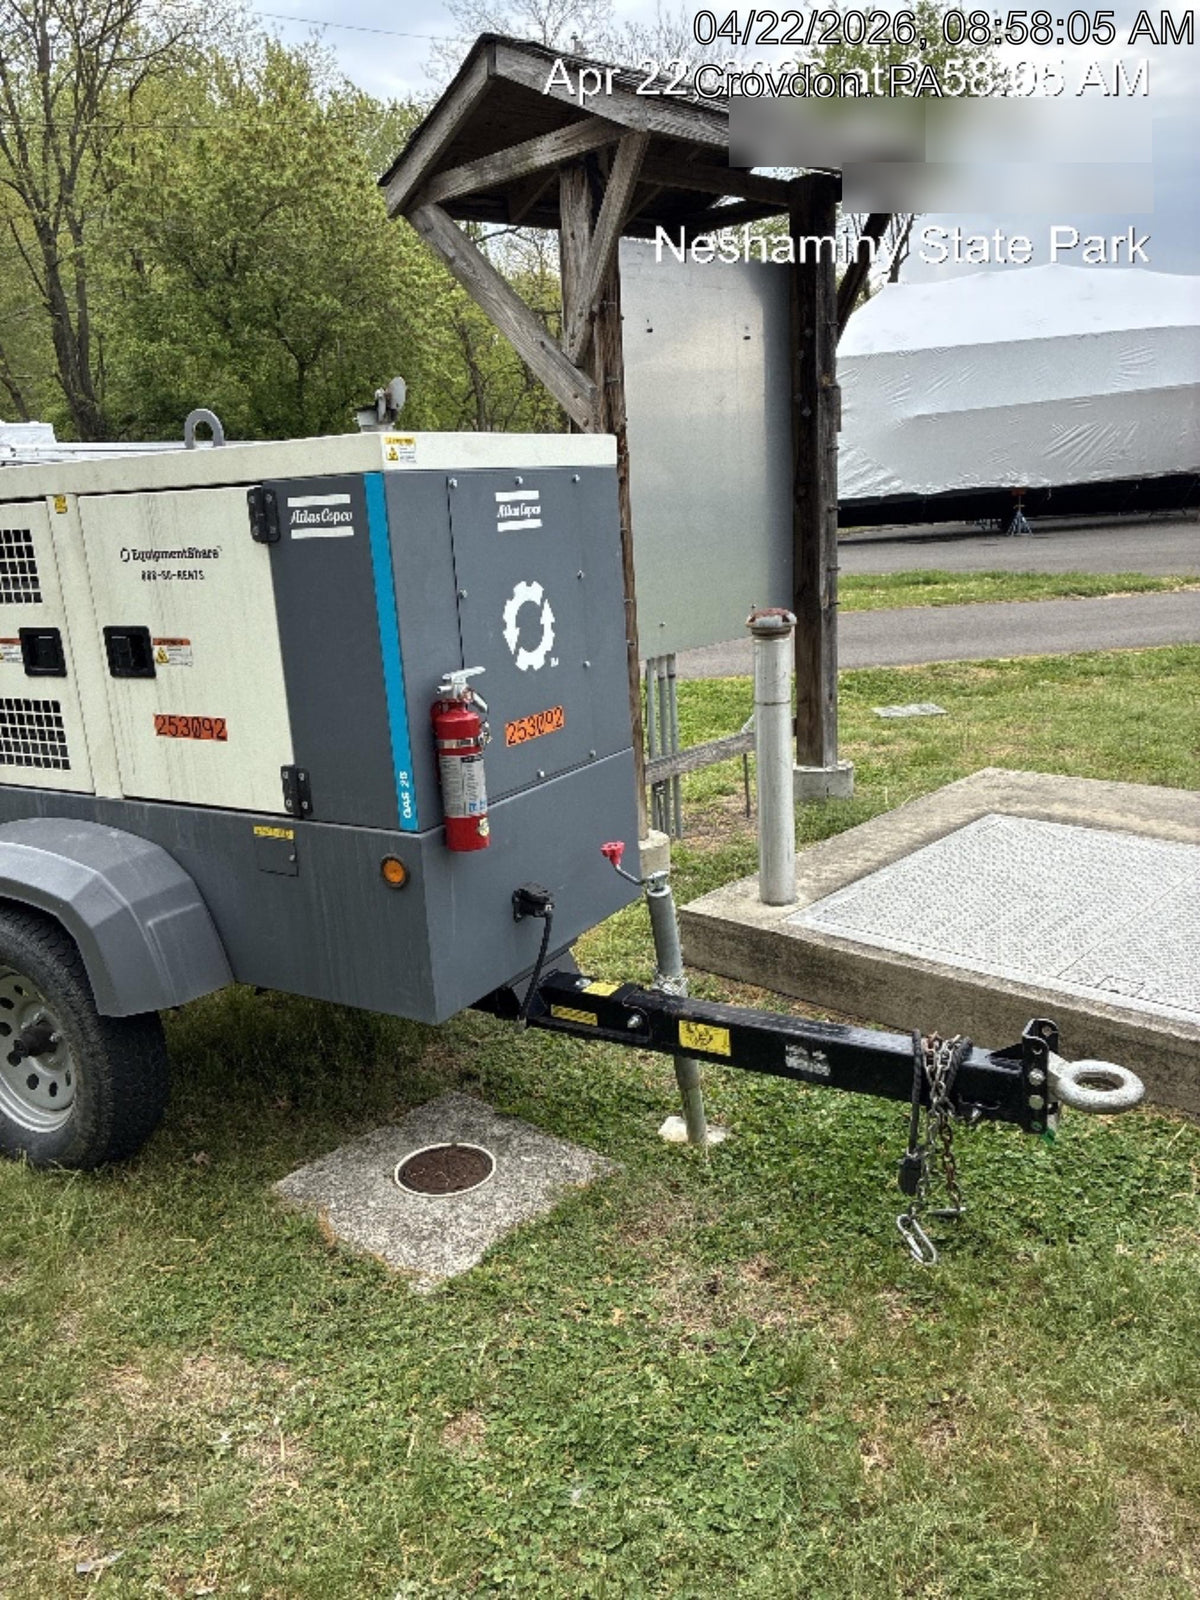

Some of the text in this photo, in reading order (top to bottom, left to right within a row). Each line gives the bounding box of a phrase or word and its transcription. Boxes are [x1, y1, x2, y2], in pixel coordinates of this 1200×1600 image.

[289, 507, 353, 526] Atlas Copco
[131, 546, 220, 562] EquipmentShare
[156, 713, 227, 740] 253092
[506, 706, 564, 745] 253092
